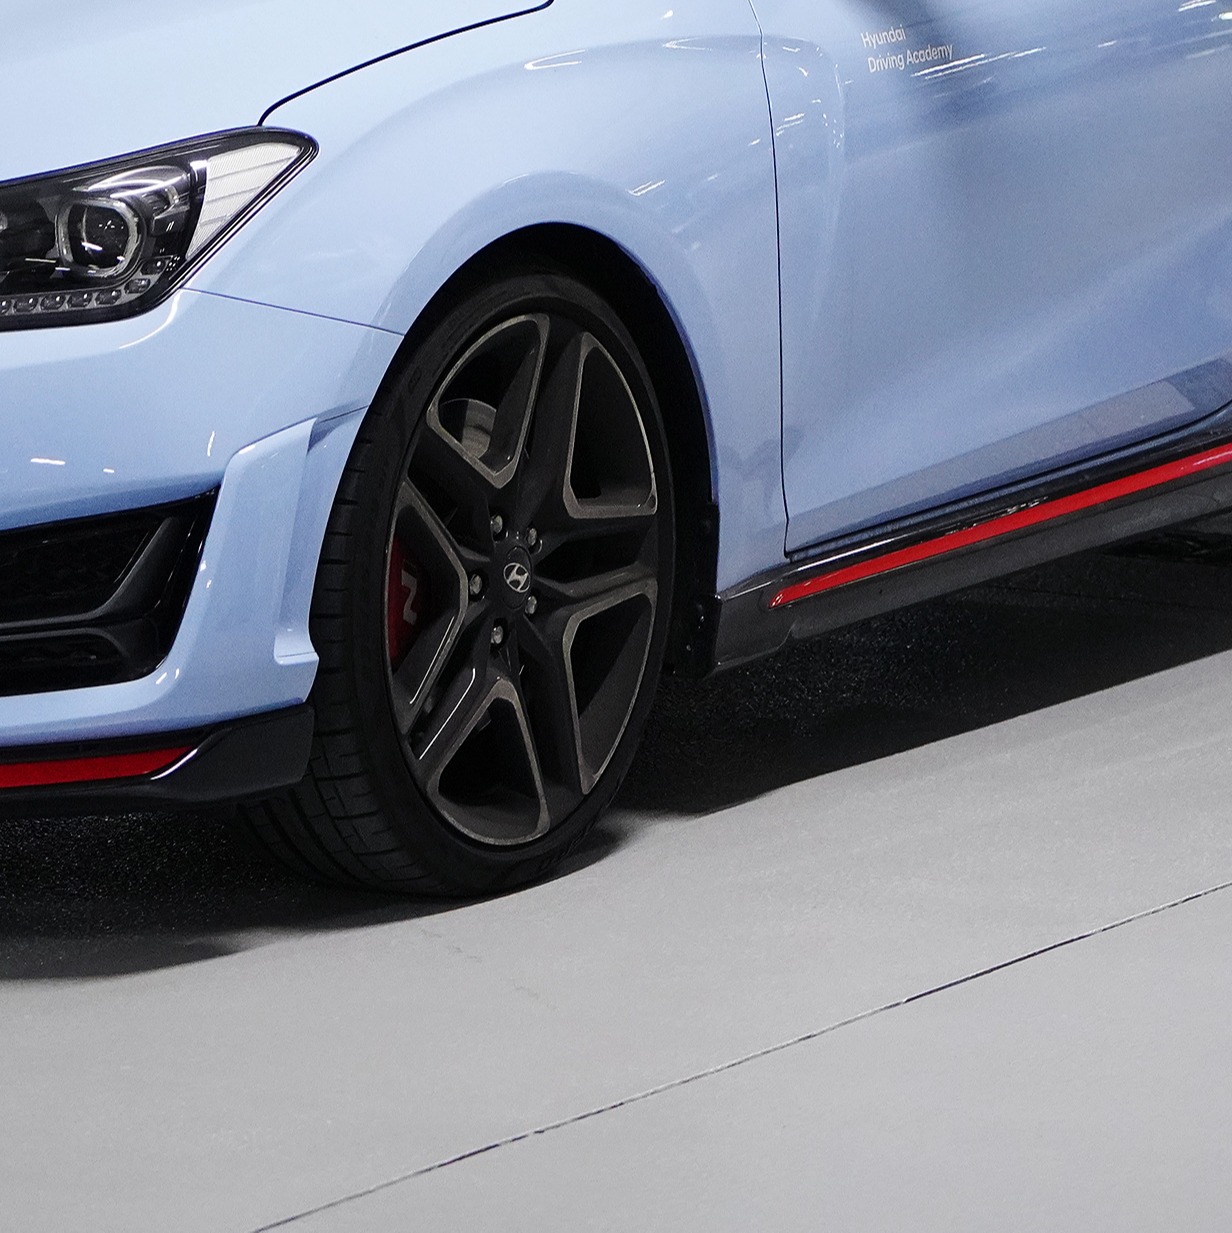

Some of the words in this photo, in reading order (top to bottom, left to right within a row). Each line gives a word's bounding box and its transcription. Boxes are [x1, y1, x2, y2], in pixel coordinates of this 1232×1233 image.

[860, 24, 907, 49] Hyundai
[867, 52, 905, 73] Driving
[906, 44, 954, 65] Academy
